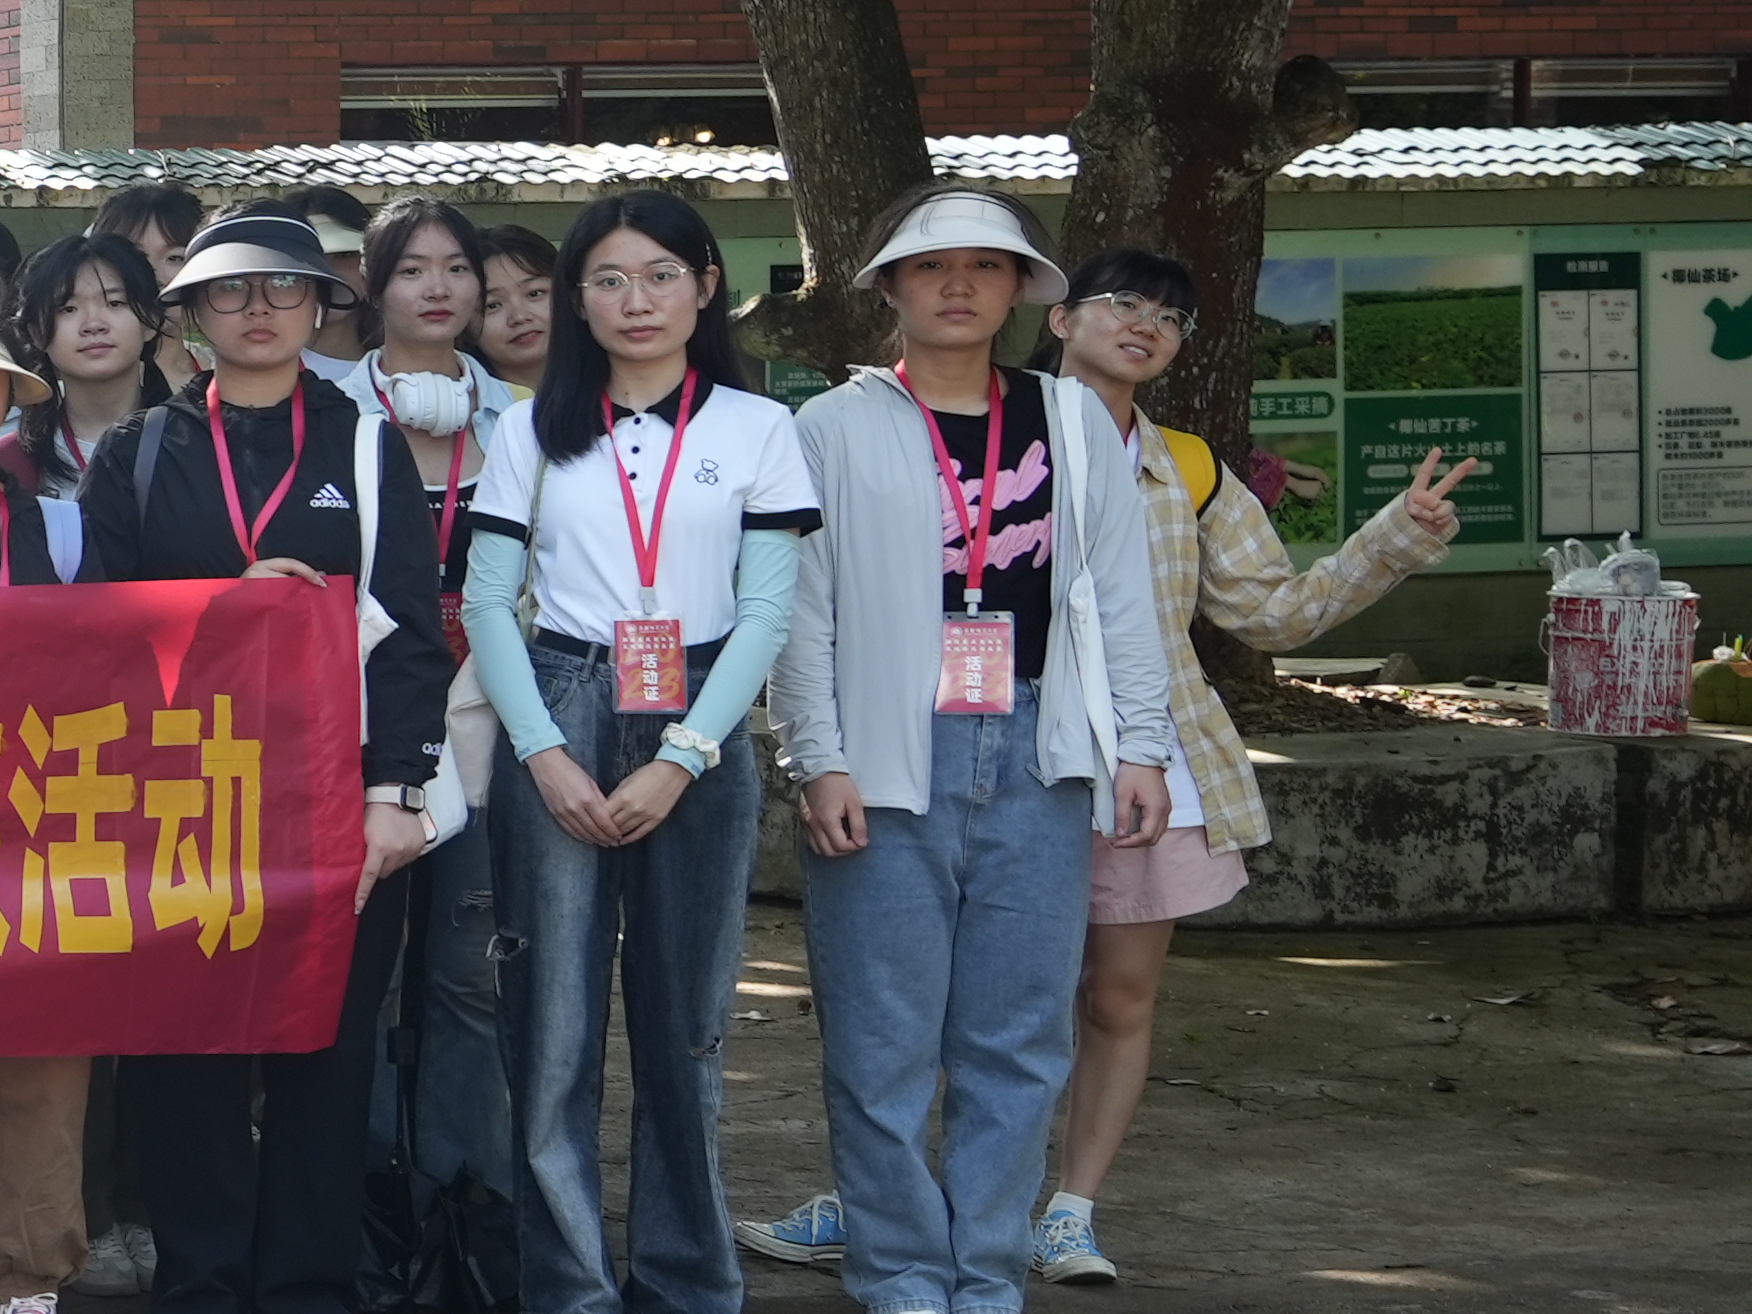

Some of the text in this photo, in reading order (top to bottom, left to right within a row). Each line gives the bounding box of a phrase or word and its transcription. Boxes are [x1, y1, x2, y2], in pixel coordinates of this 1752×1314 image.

[309, 498, 351, 509] adidas
[641, 653, 660, 701] 活动证
[965, 655, 983, 703] 活动证
